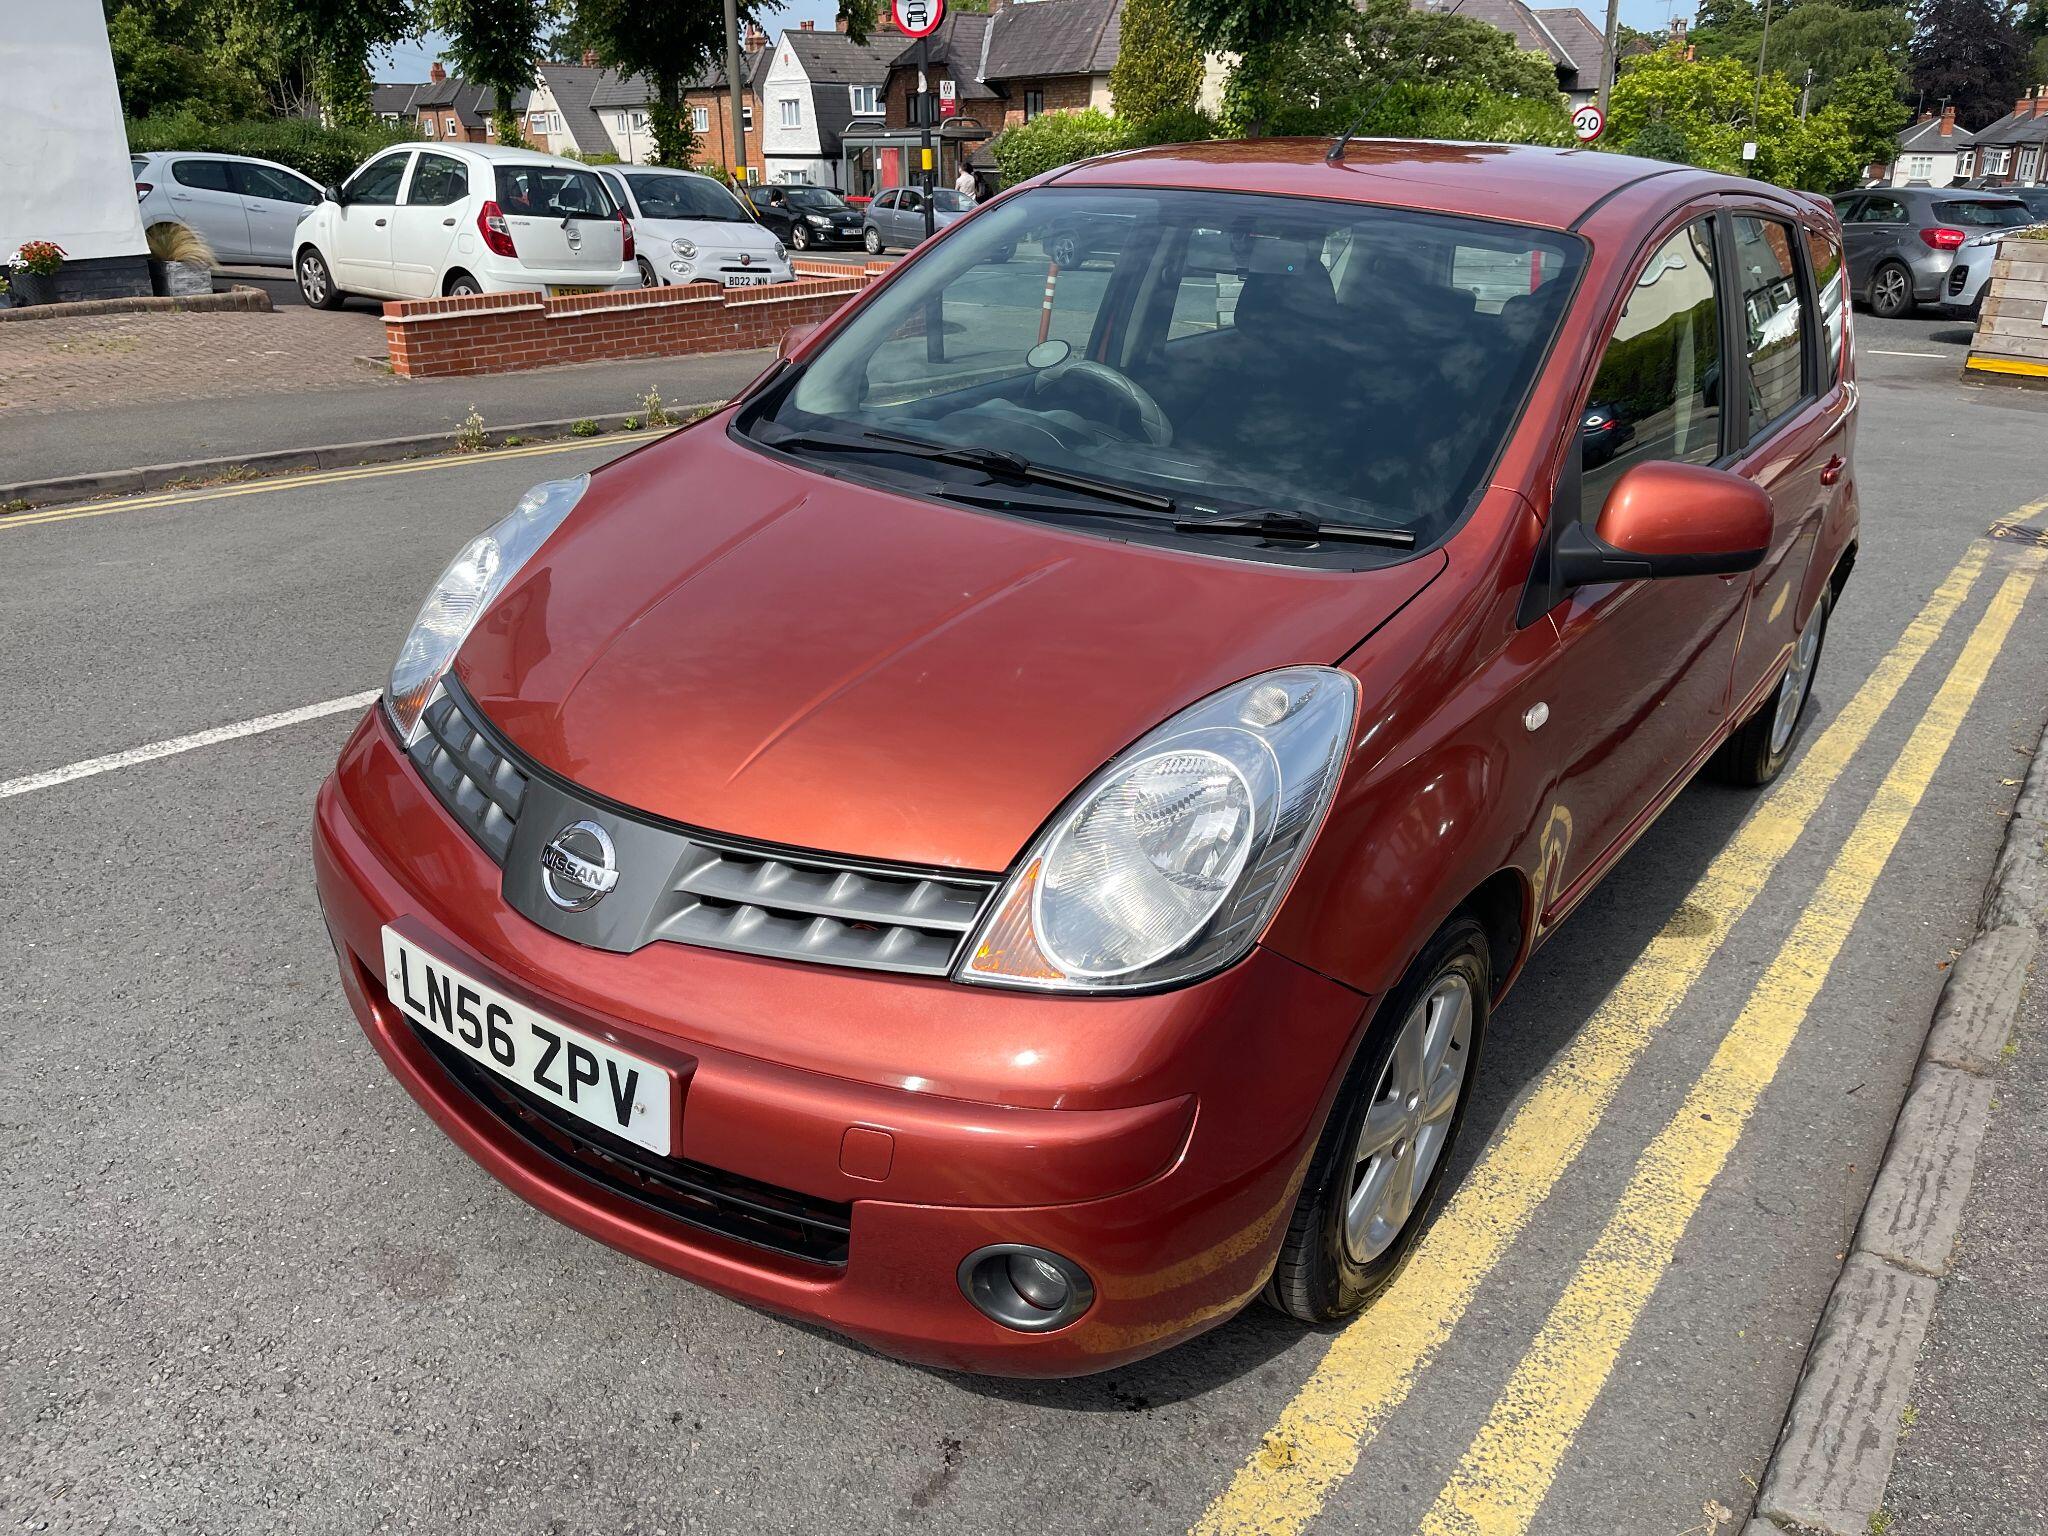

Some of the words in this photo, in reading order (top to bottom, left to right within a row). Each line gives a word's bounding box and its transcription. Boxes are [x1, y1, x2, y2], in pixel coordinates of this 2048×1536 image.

[1577, 117, 1599, 130] 20
[729, 276, 751, 286] BD22
[752, 276, 768, 286] JWN
[541, 848, 606, 886] NISSAN
[399, 946, 516, 1068] LN56
[530, 1022, 640, 1128] ZPV
